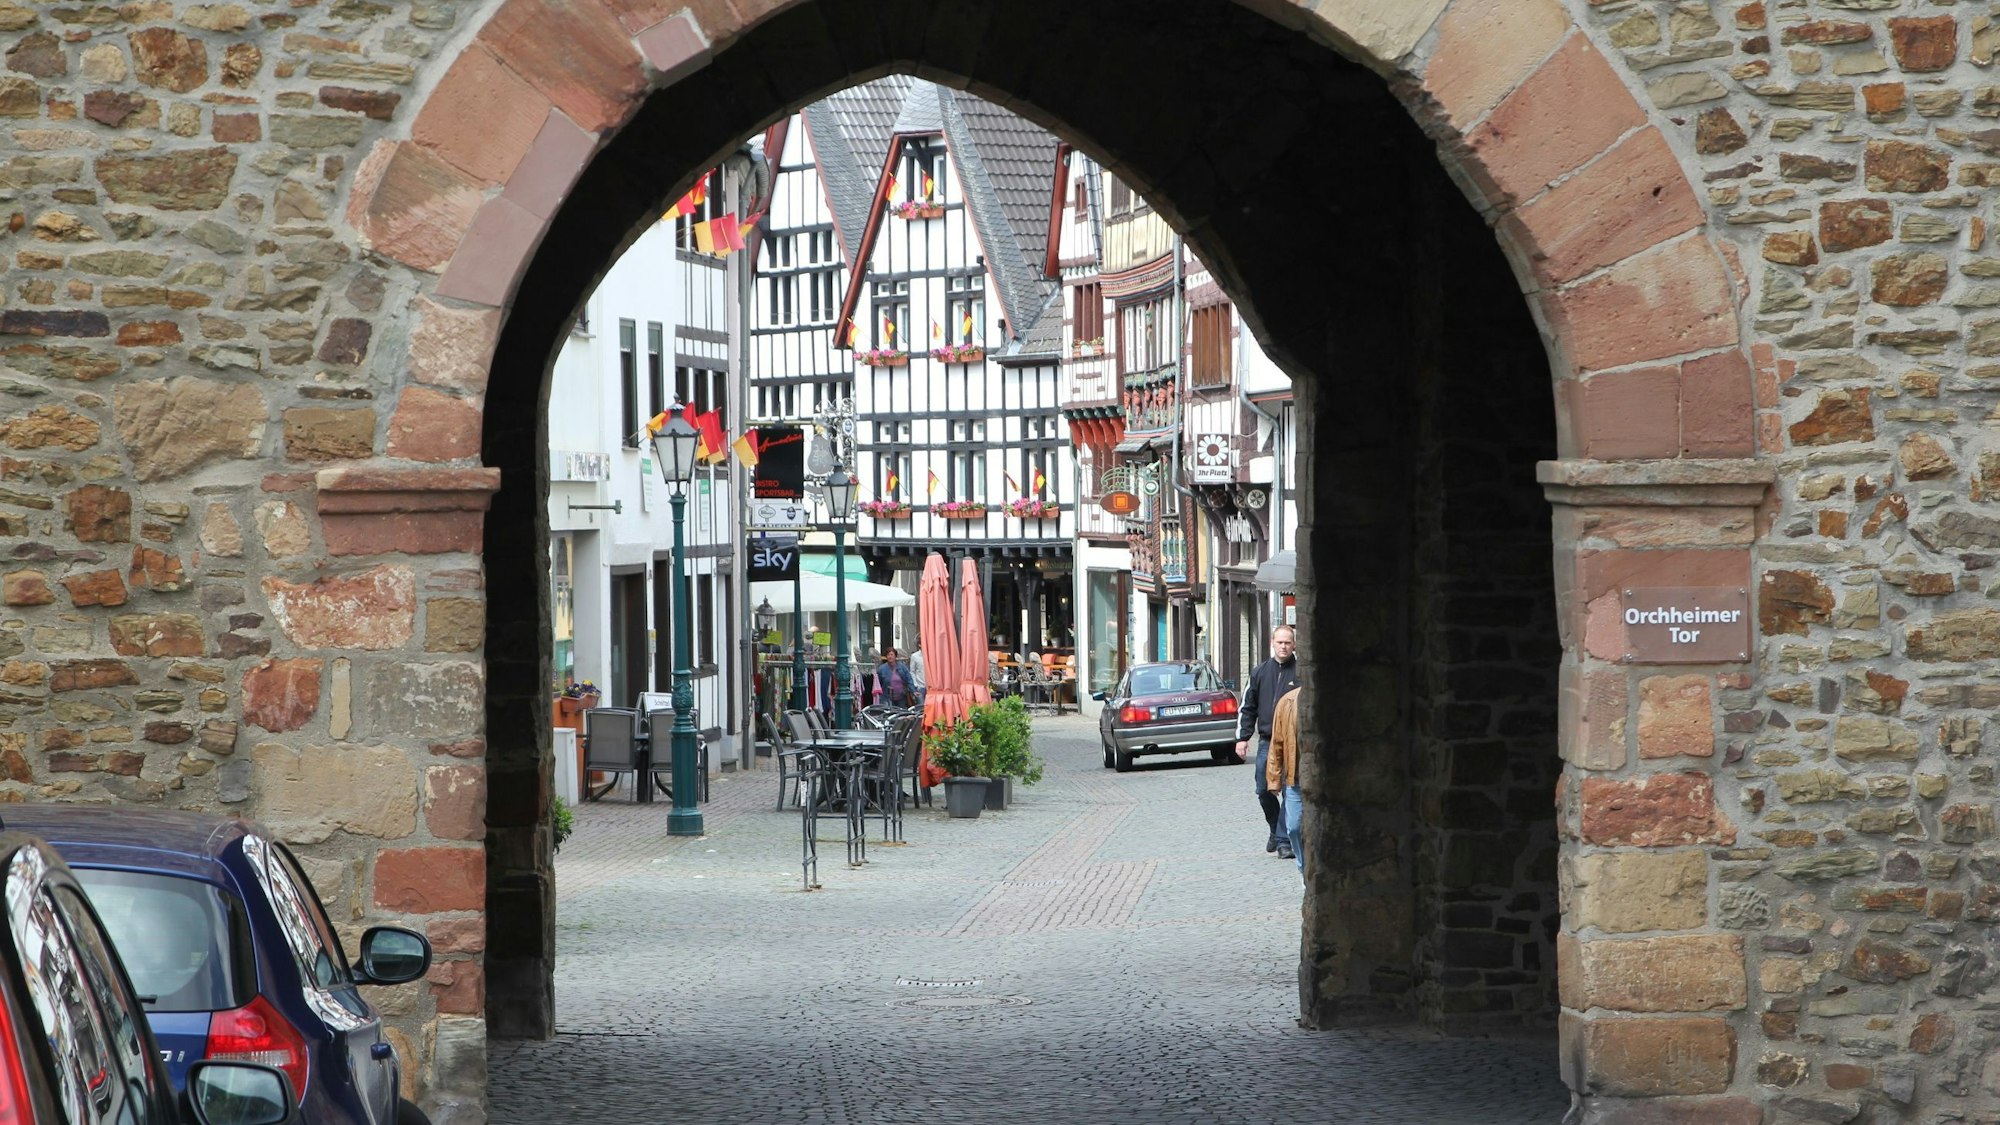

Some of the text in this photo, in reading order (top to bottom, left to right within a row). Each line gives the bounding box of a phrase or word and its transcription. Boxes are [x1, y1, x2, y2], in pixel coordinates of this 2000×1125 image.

[1209, 468, 1228, 476] Platz
[756, 489, 794, 497] SPORTSBAR
[753, 548, 792, 571] sky
[1625, 606, 1741, 625] Orchheimer
[1669, 627, 1700, 643] Tor
